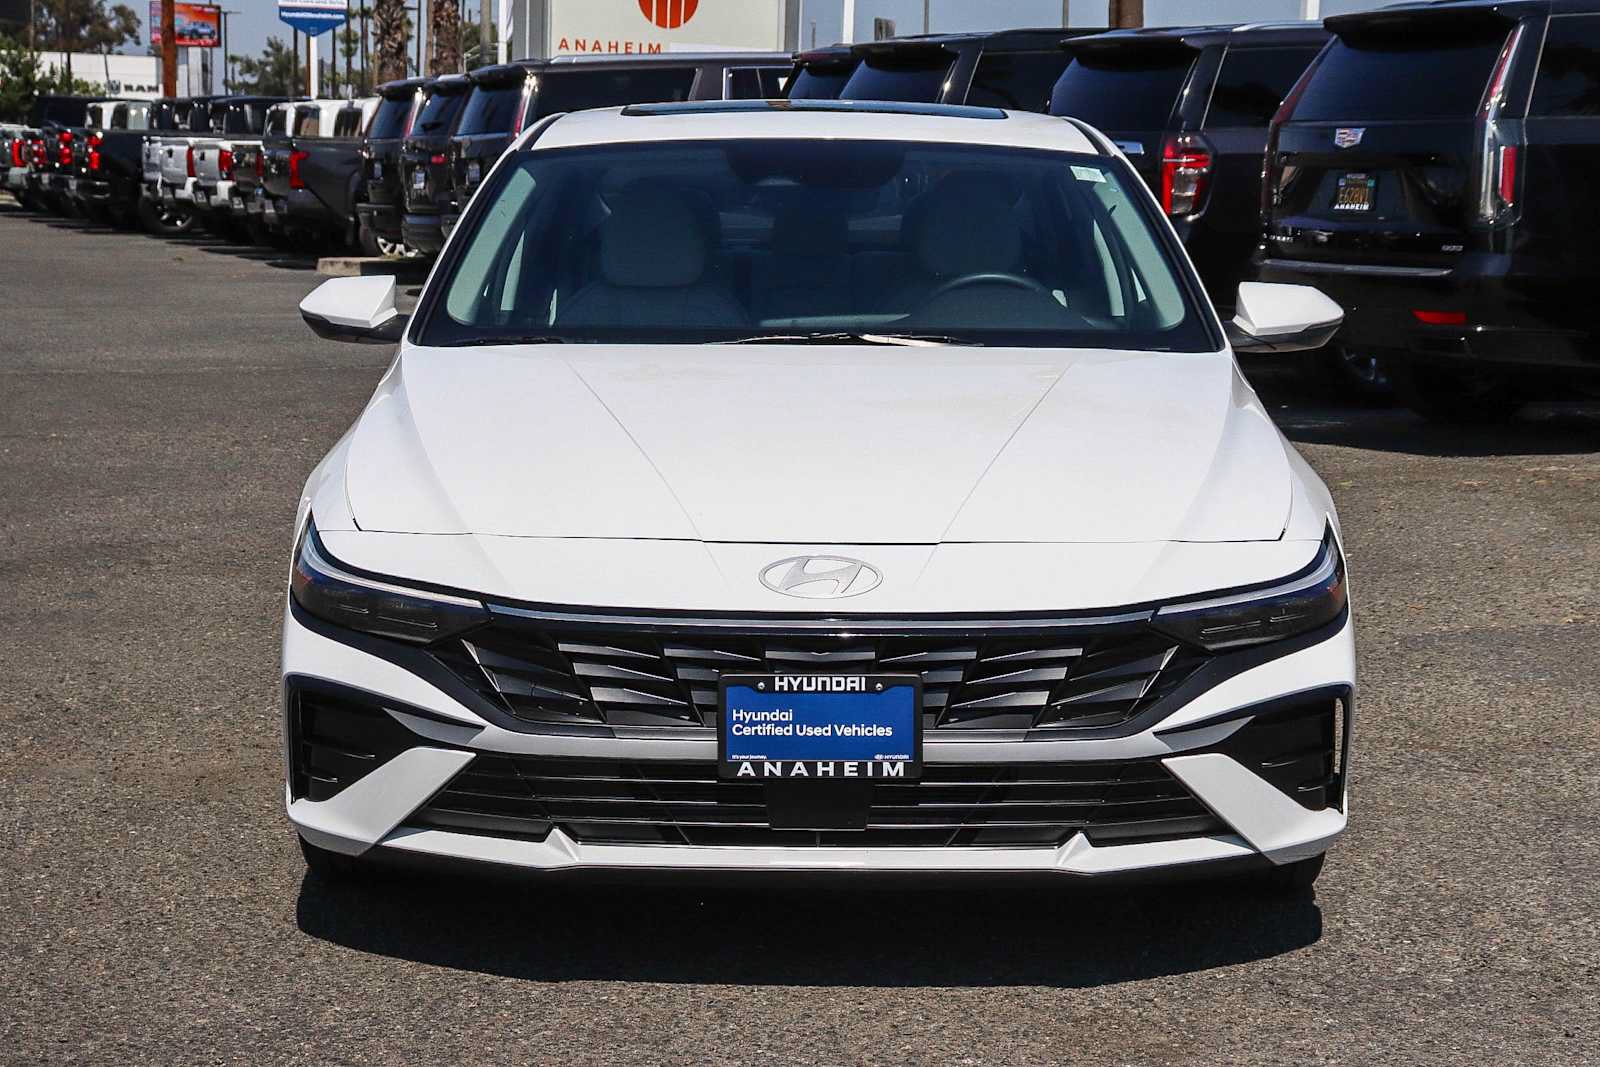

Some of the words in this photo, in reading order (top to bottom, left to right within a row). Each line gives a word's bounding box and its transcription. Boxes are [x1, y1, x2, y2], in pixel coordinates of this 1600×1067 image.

[558, 37, 663, 55] ANAHEIM
[124, 84, 159, 93] RAM
[774, 676, 866, 692] HYUNDAI
[732, 709, 793, 723] Hyundai
[732, 723, 793, 737] Certified
[796, 725, 832, 737] Used
[834, 725, 893, 737] Vehicles
[736, 761, 905, 777] ANAHEIM
